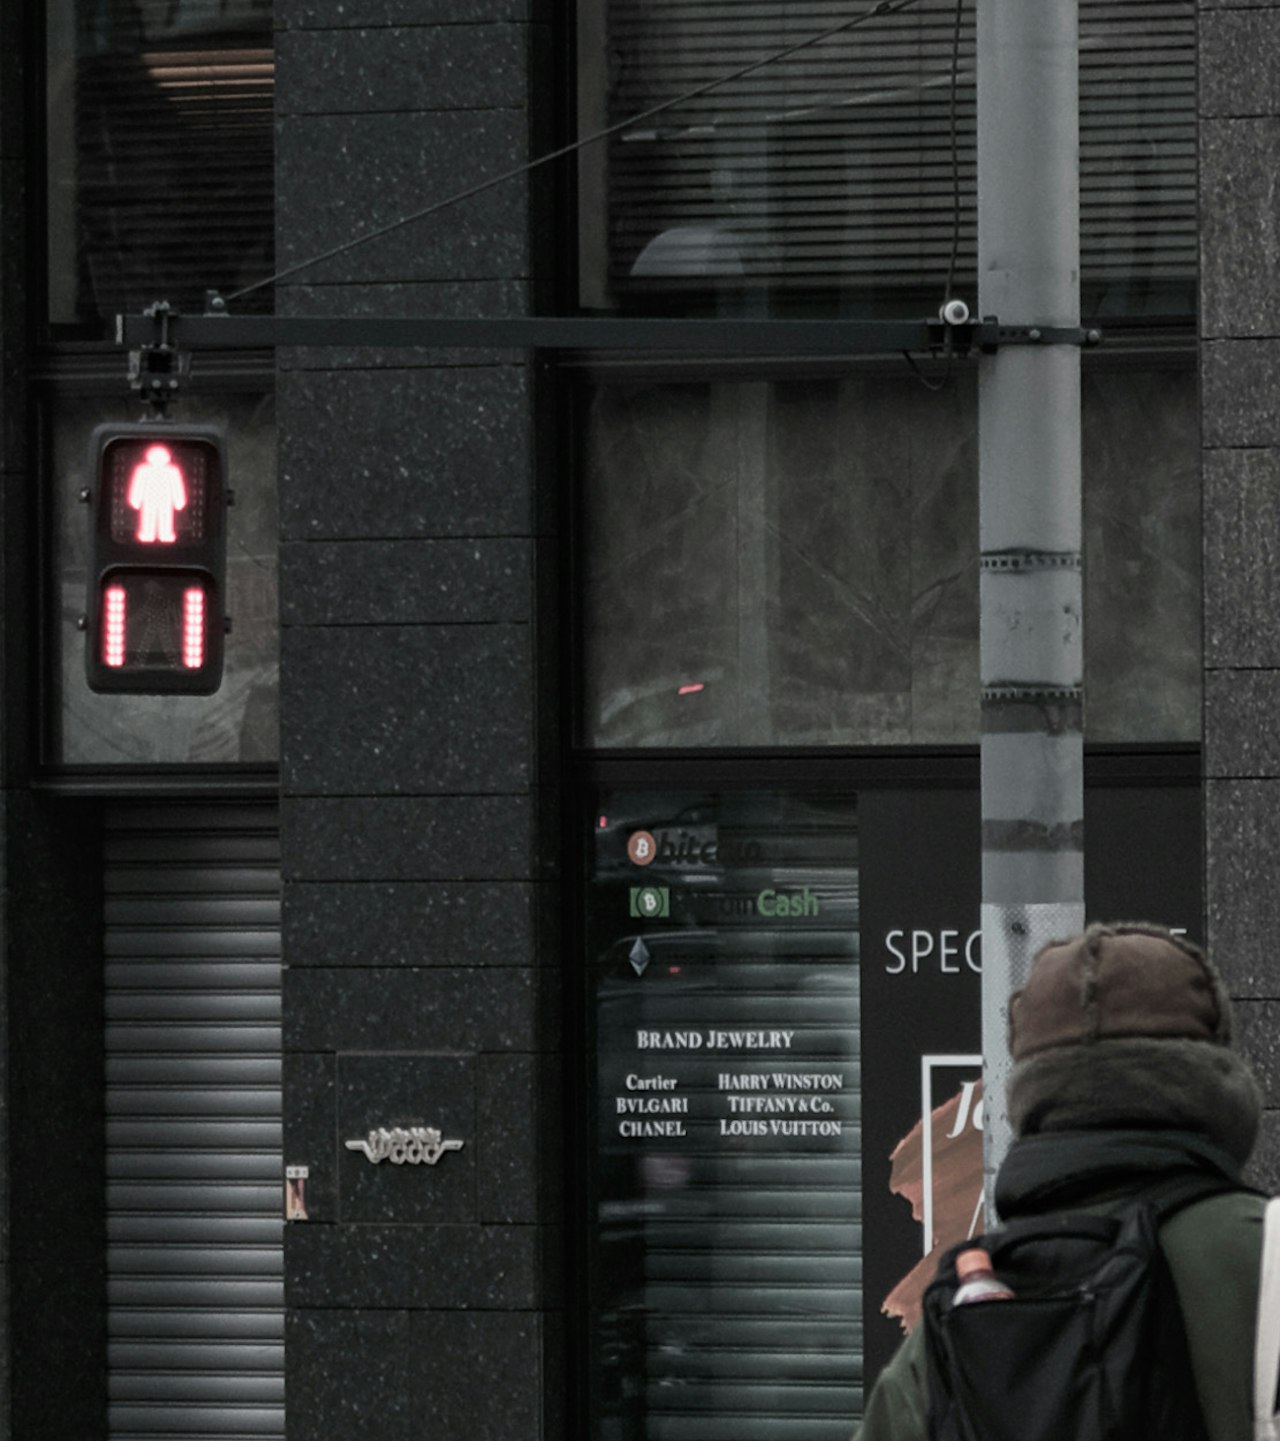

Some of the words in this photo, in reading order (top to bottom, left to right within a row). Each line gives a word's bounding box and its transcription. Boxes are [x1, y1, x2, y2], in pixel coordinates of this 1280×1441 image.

[636, 1030, 703, 1050] BRAND
[706, 1029, 795, 1050] JEWELRY
[625, 1073, 678, 1092] Cartier
[717, 1073, 769, 1091] HARRY
[772, 1073, 843, 1091] WINSTON
[616, 1097, 689, 1115] BVLGARI
[618, 1121, 687, 1138] CHANEL
[720, 1119, 769, 1137] LOUIS
[772, 1119, 842, 1137] VUITTON
